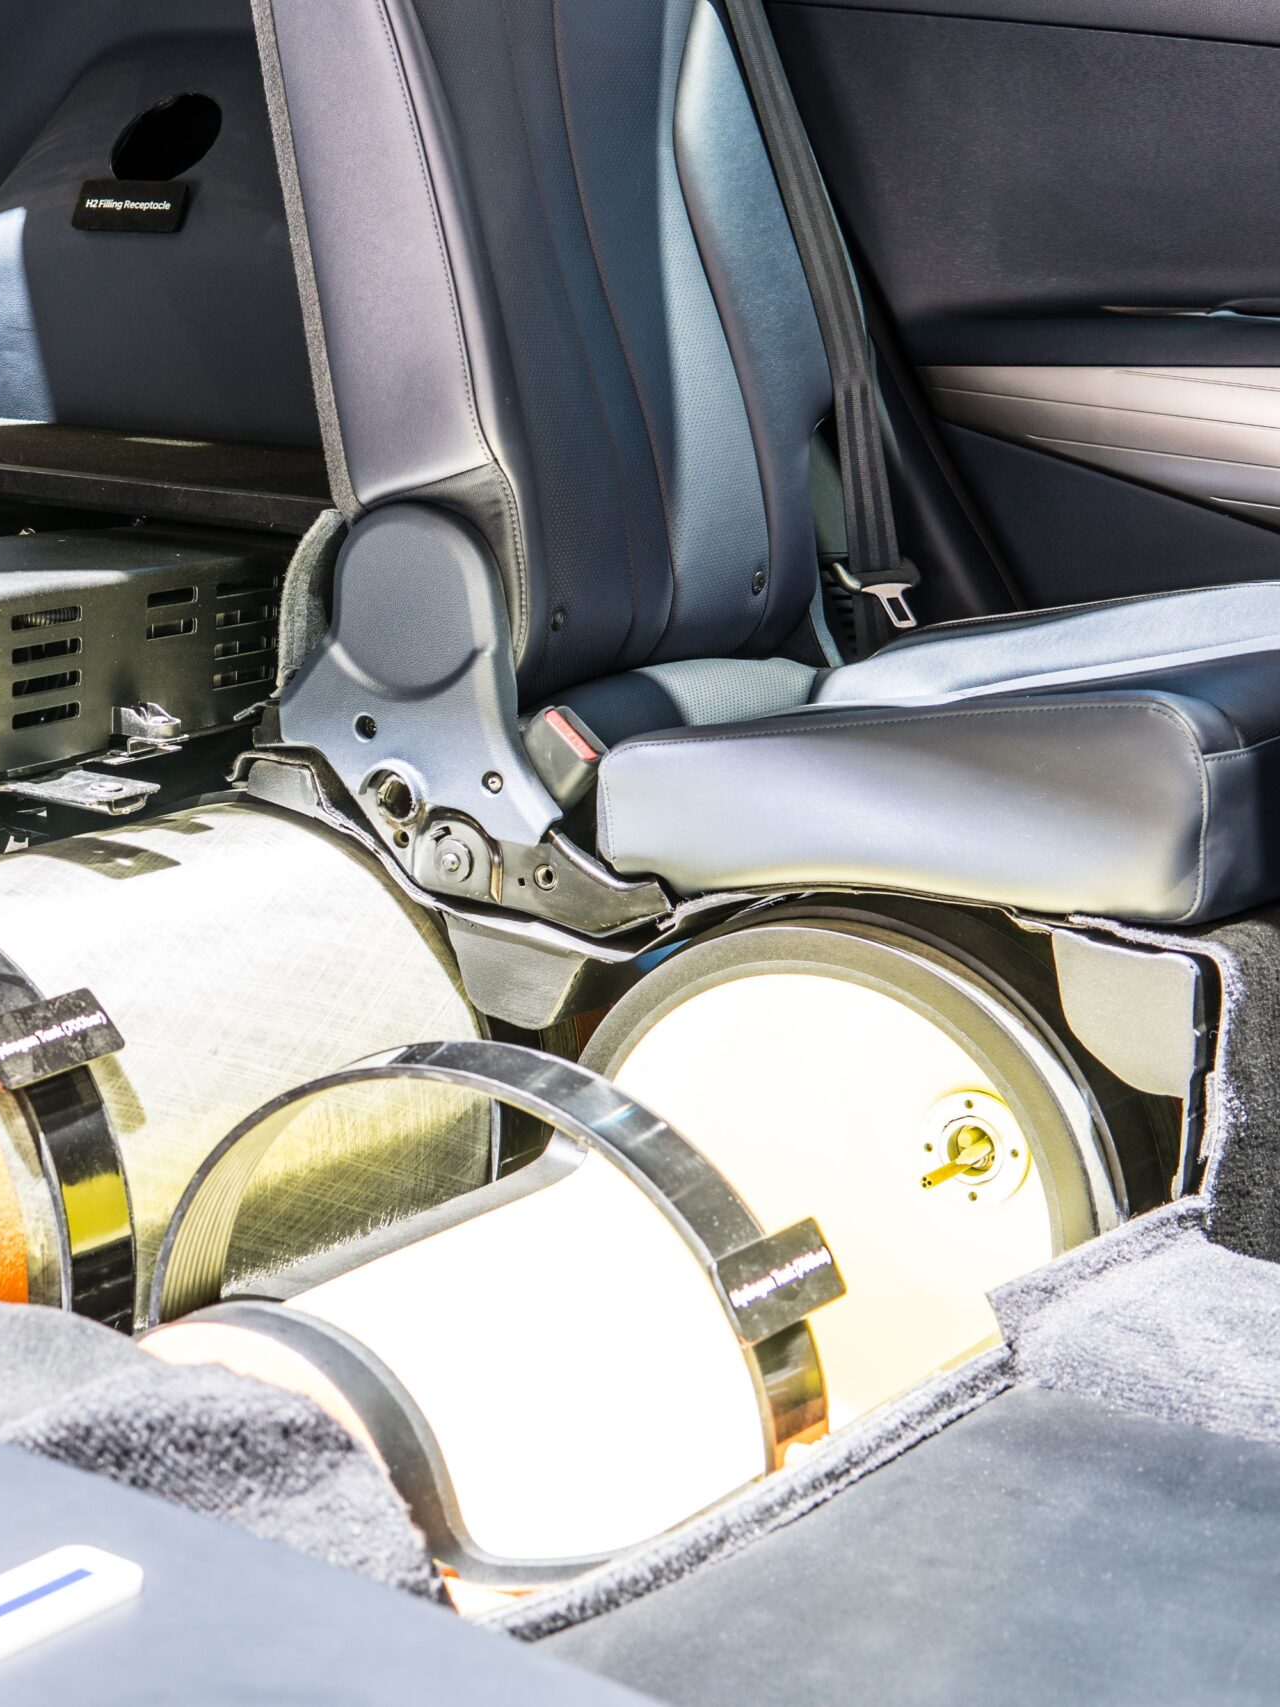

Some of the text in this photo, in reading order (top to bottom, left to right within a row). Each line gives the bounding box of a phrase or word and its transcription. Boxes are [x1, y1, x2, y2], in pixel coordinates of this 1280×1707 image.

[86, 199, 171, 211] H2 Filling Receptacle
[35, 1025, 65, 1042] Tank
